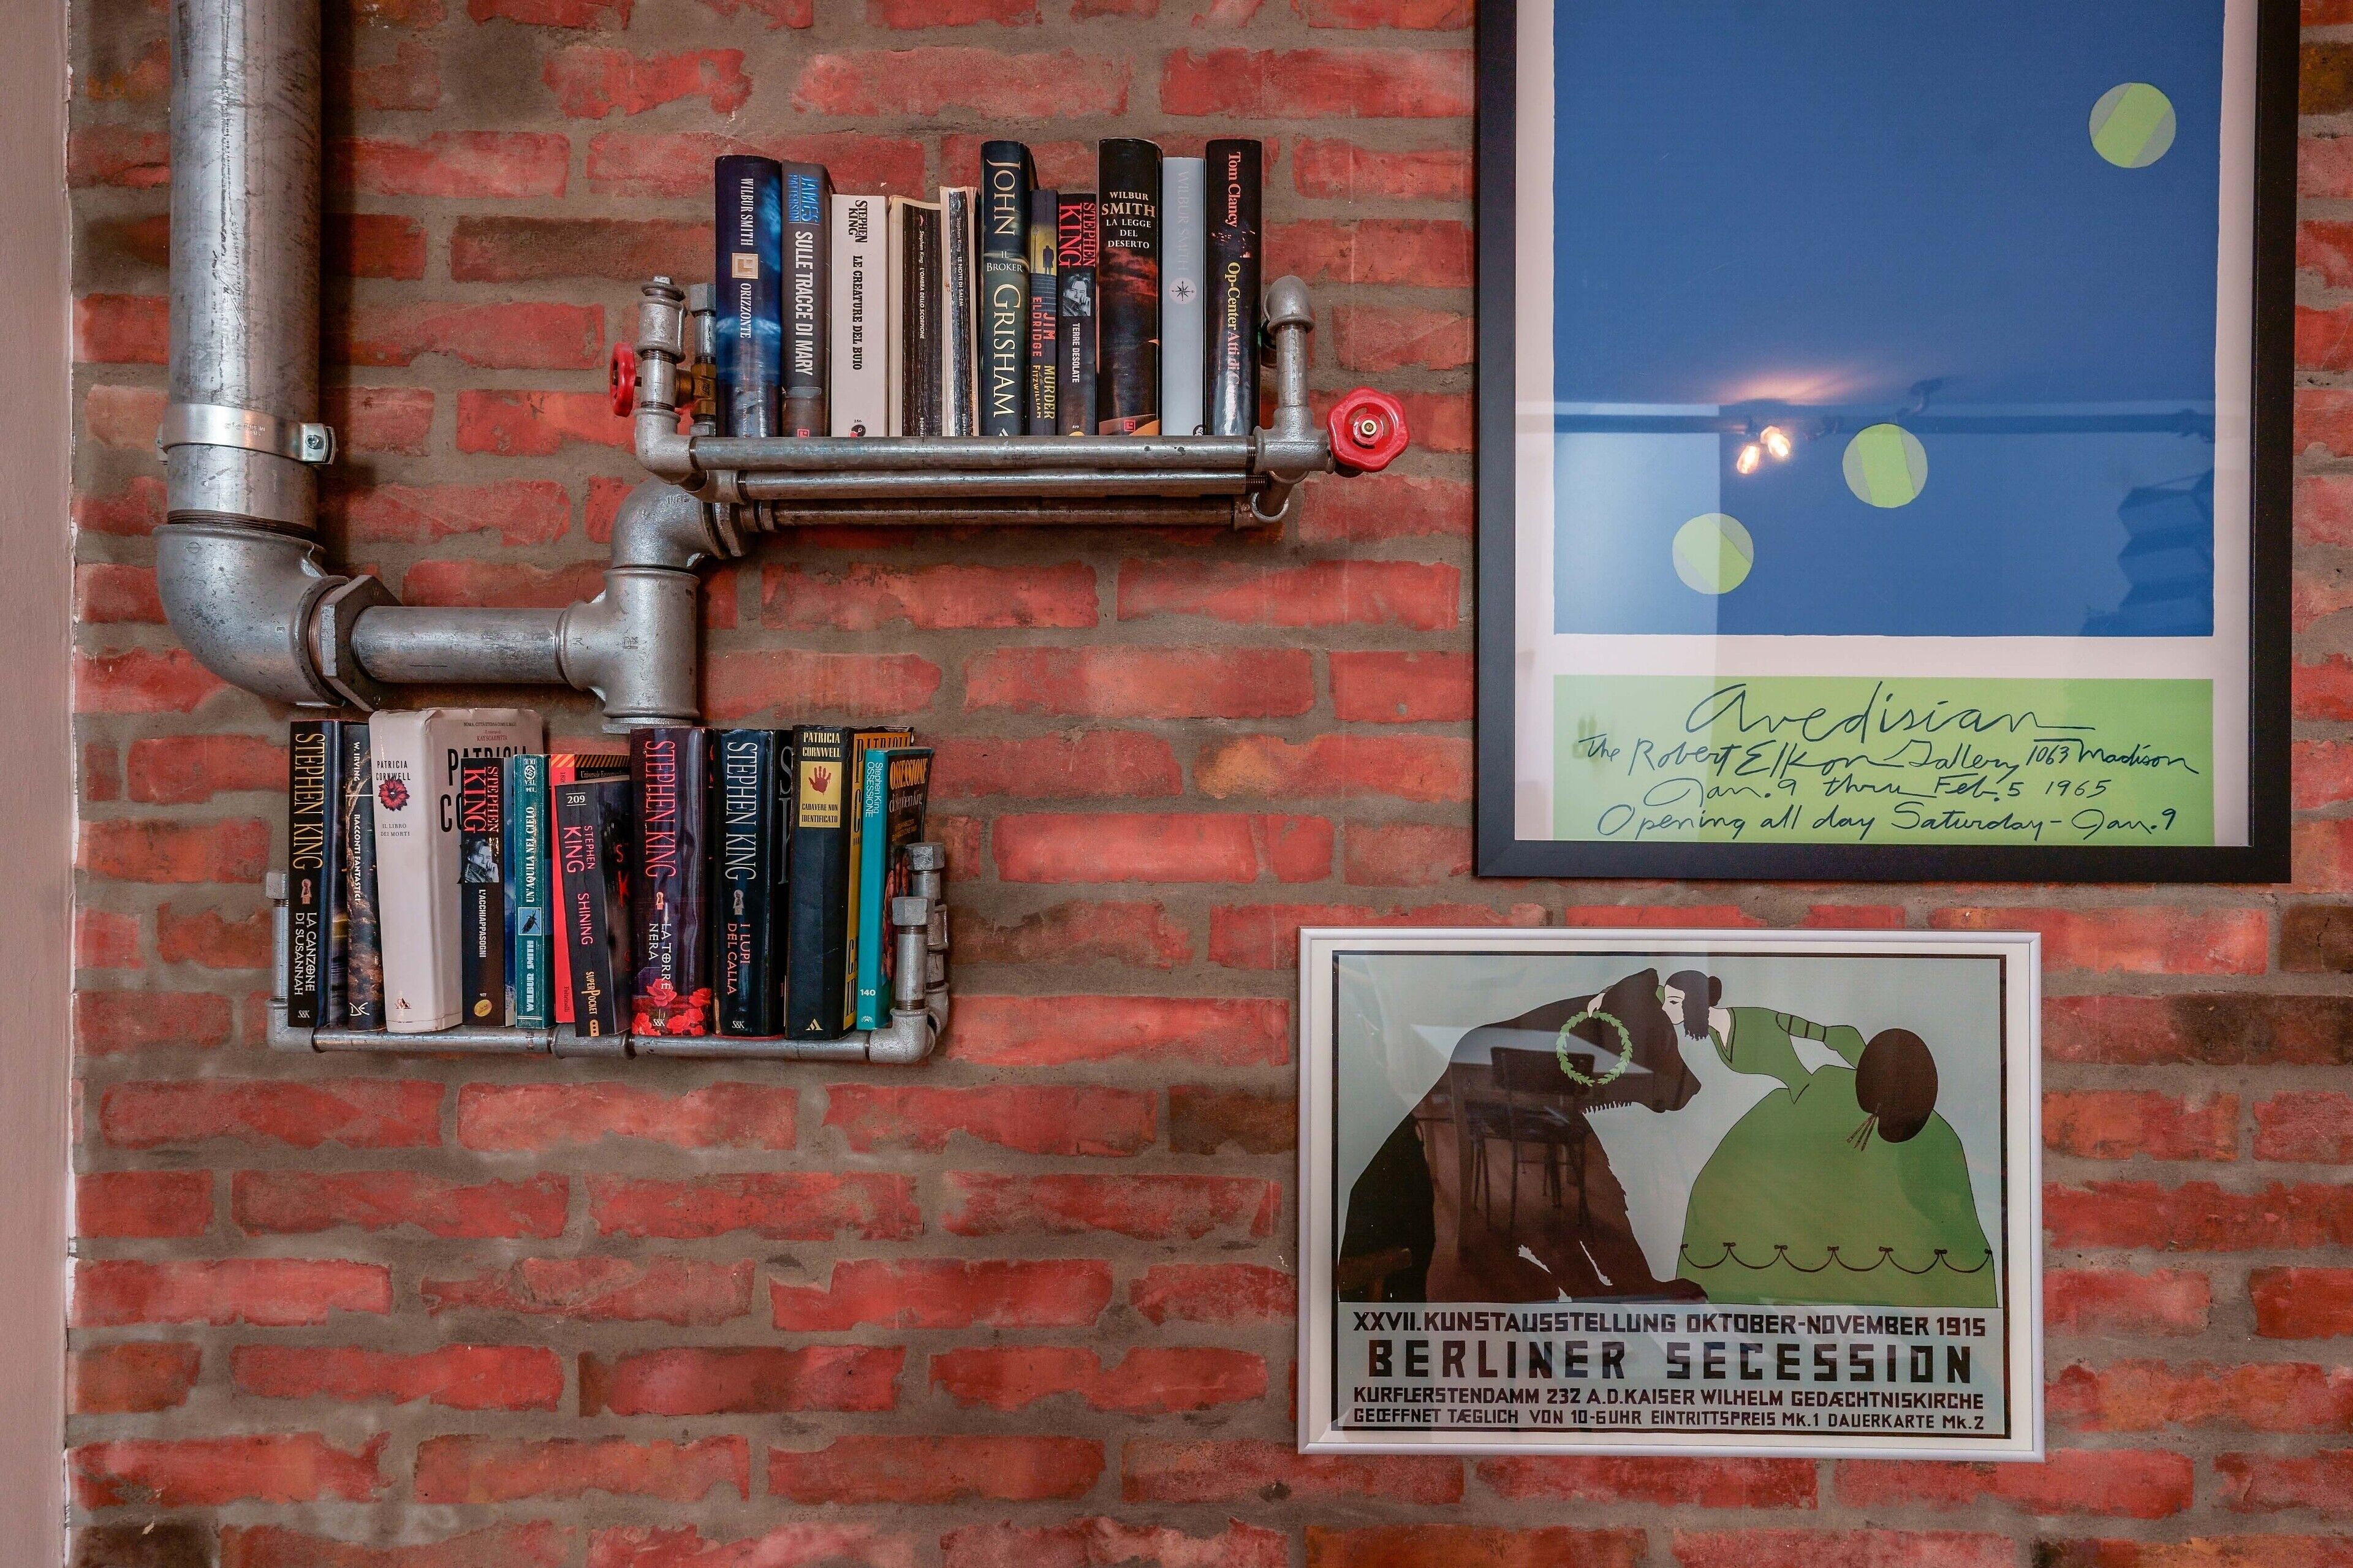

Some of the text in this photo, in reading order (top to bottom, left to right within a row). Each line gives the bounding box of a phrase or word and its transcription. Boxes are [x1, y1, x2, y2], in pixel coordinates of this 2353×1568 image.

[740, 178, 753, 246] WILBUR SMITH
[788, 174, 799, 221] PATTERSON
[801, 175, 820, 222] JAMES
[987, 159, 1021, 237] JOHN
[1101, 203, 1155, 218] SMITH
[1110, 191, 1149, 201] WILBUR
[1225, 151, 1241, 227] Tom Clancy
[848, 208, 858, 236] KING
[855, 200, 868, 243] STEPHEN
[1059, 203, 1082, 268] KING
[1083, 202, 1096, 267] STEPHEN
[1121, 219, 1151, 228] LEGGE
[1178, 171, 1190, 270] WILBUR SMITH
[1107, 240, 1150, 249] DESERTO
[740, 282, 752, 338] ORIZZONTE
[795, 231, 813, 376] SULLE TRACCE DI MARY
[853, 256, 863, 370] LE CREATURE DEL BUIO
[1225, 262, 1241, 330] Op-Center
[1032, 296, 1042, 357] ELDRIDGE
[1043, 312, 1055, 340] JIM
[1227, 331, 1240, 355] Atti
[993, 284, 1021, 418] GRISHAM
[1072, 347, 1080, 383] DESOLATE
[1032, 365, 1041, 419] FITZWILLIAM
[1044, 365, 1055, 419] MURDER
[354, 741, 360, 751] W.
[802, 746, 841, 758] CORNWELL
[803, 732, 841, 744] PATRICIA
[1578, 733, 1620, 762] The
[1627, 738, 1742, 776] Robert
[1734, 740, 1904, 778] Elkon
[1883, 739, 2020, 784] Gallery
[2026, 744, 2069, 765] 1063
[376, 772, 411, 781] CORNWELL
[377, 760, 408, 769] PATRICIA
[890, 758, 928, 790] OSSESSIONE
[292, 733, 326, 870] STEPHEN KING
[464, 767, 487, 833] KING
[488, 767, 499, 833] STEPHEN
[567, 795, 586, 803] 209
[645, 740, 676, 878] STEPHEN KING
[865, 761, 875, 817] OSSESSIONE
[873, 762, 884, 814] Stephen King
[895, 790, 912, 815] Stephen
[2007, 782, 2024, 797] 5
[2045, 779, 2112, 798] 1965
[725, 742, 758, 881] STEPHEN KING
[801, 814, 838, 823] IDENTIFICATO
[1597, 804, 1745, 840] Opening
[1760, 805, 1803, 829] all
[1812, 805, 1875, 841] day
[1891, 801, 2044, 841] Saturday
[526, 807, 536, 903] UN'AQUILA NEL CIELO
[564, 827, 585, 873] KING
[584, 825, 596, 869] STEPHEN
[577, 893, 593, 945] SHINING
[648, 923, 659, 961] NERA
[294, 912, 305, 995] DI SUSANNAH
[305, 912, 317, 991] LA CANZONE
[661, 923, 672, 990] LA TORRE
[727, 923, 738, 996] DEL CALLA
[740, 934, 751, 964] LUPI
[653, 1018, 665, 1027] S&K
[732, 1020, 745, 1029] S&K
[1936, 1317, 1986, 1337] 1915
[1368, 1339, 1971, 1384] BERLINER SECESSION
[1447, 1409, 1519, 1425] TÆGLICH
[1529, 1409, 1564, 1424] VON
[1651, 1410, 1776, 1426] EINTRITTSPREIS
[1828, 1413, 1935, 1430] DAUERKARTE
[1547, 1388, 1581, 1404] 232
[1700, 1388, 1783, 1406] WILHELM
[1790, 1390, 1984, 1410] GEDÆCHTNISKIRCHE
